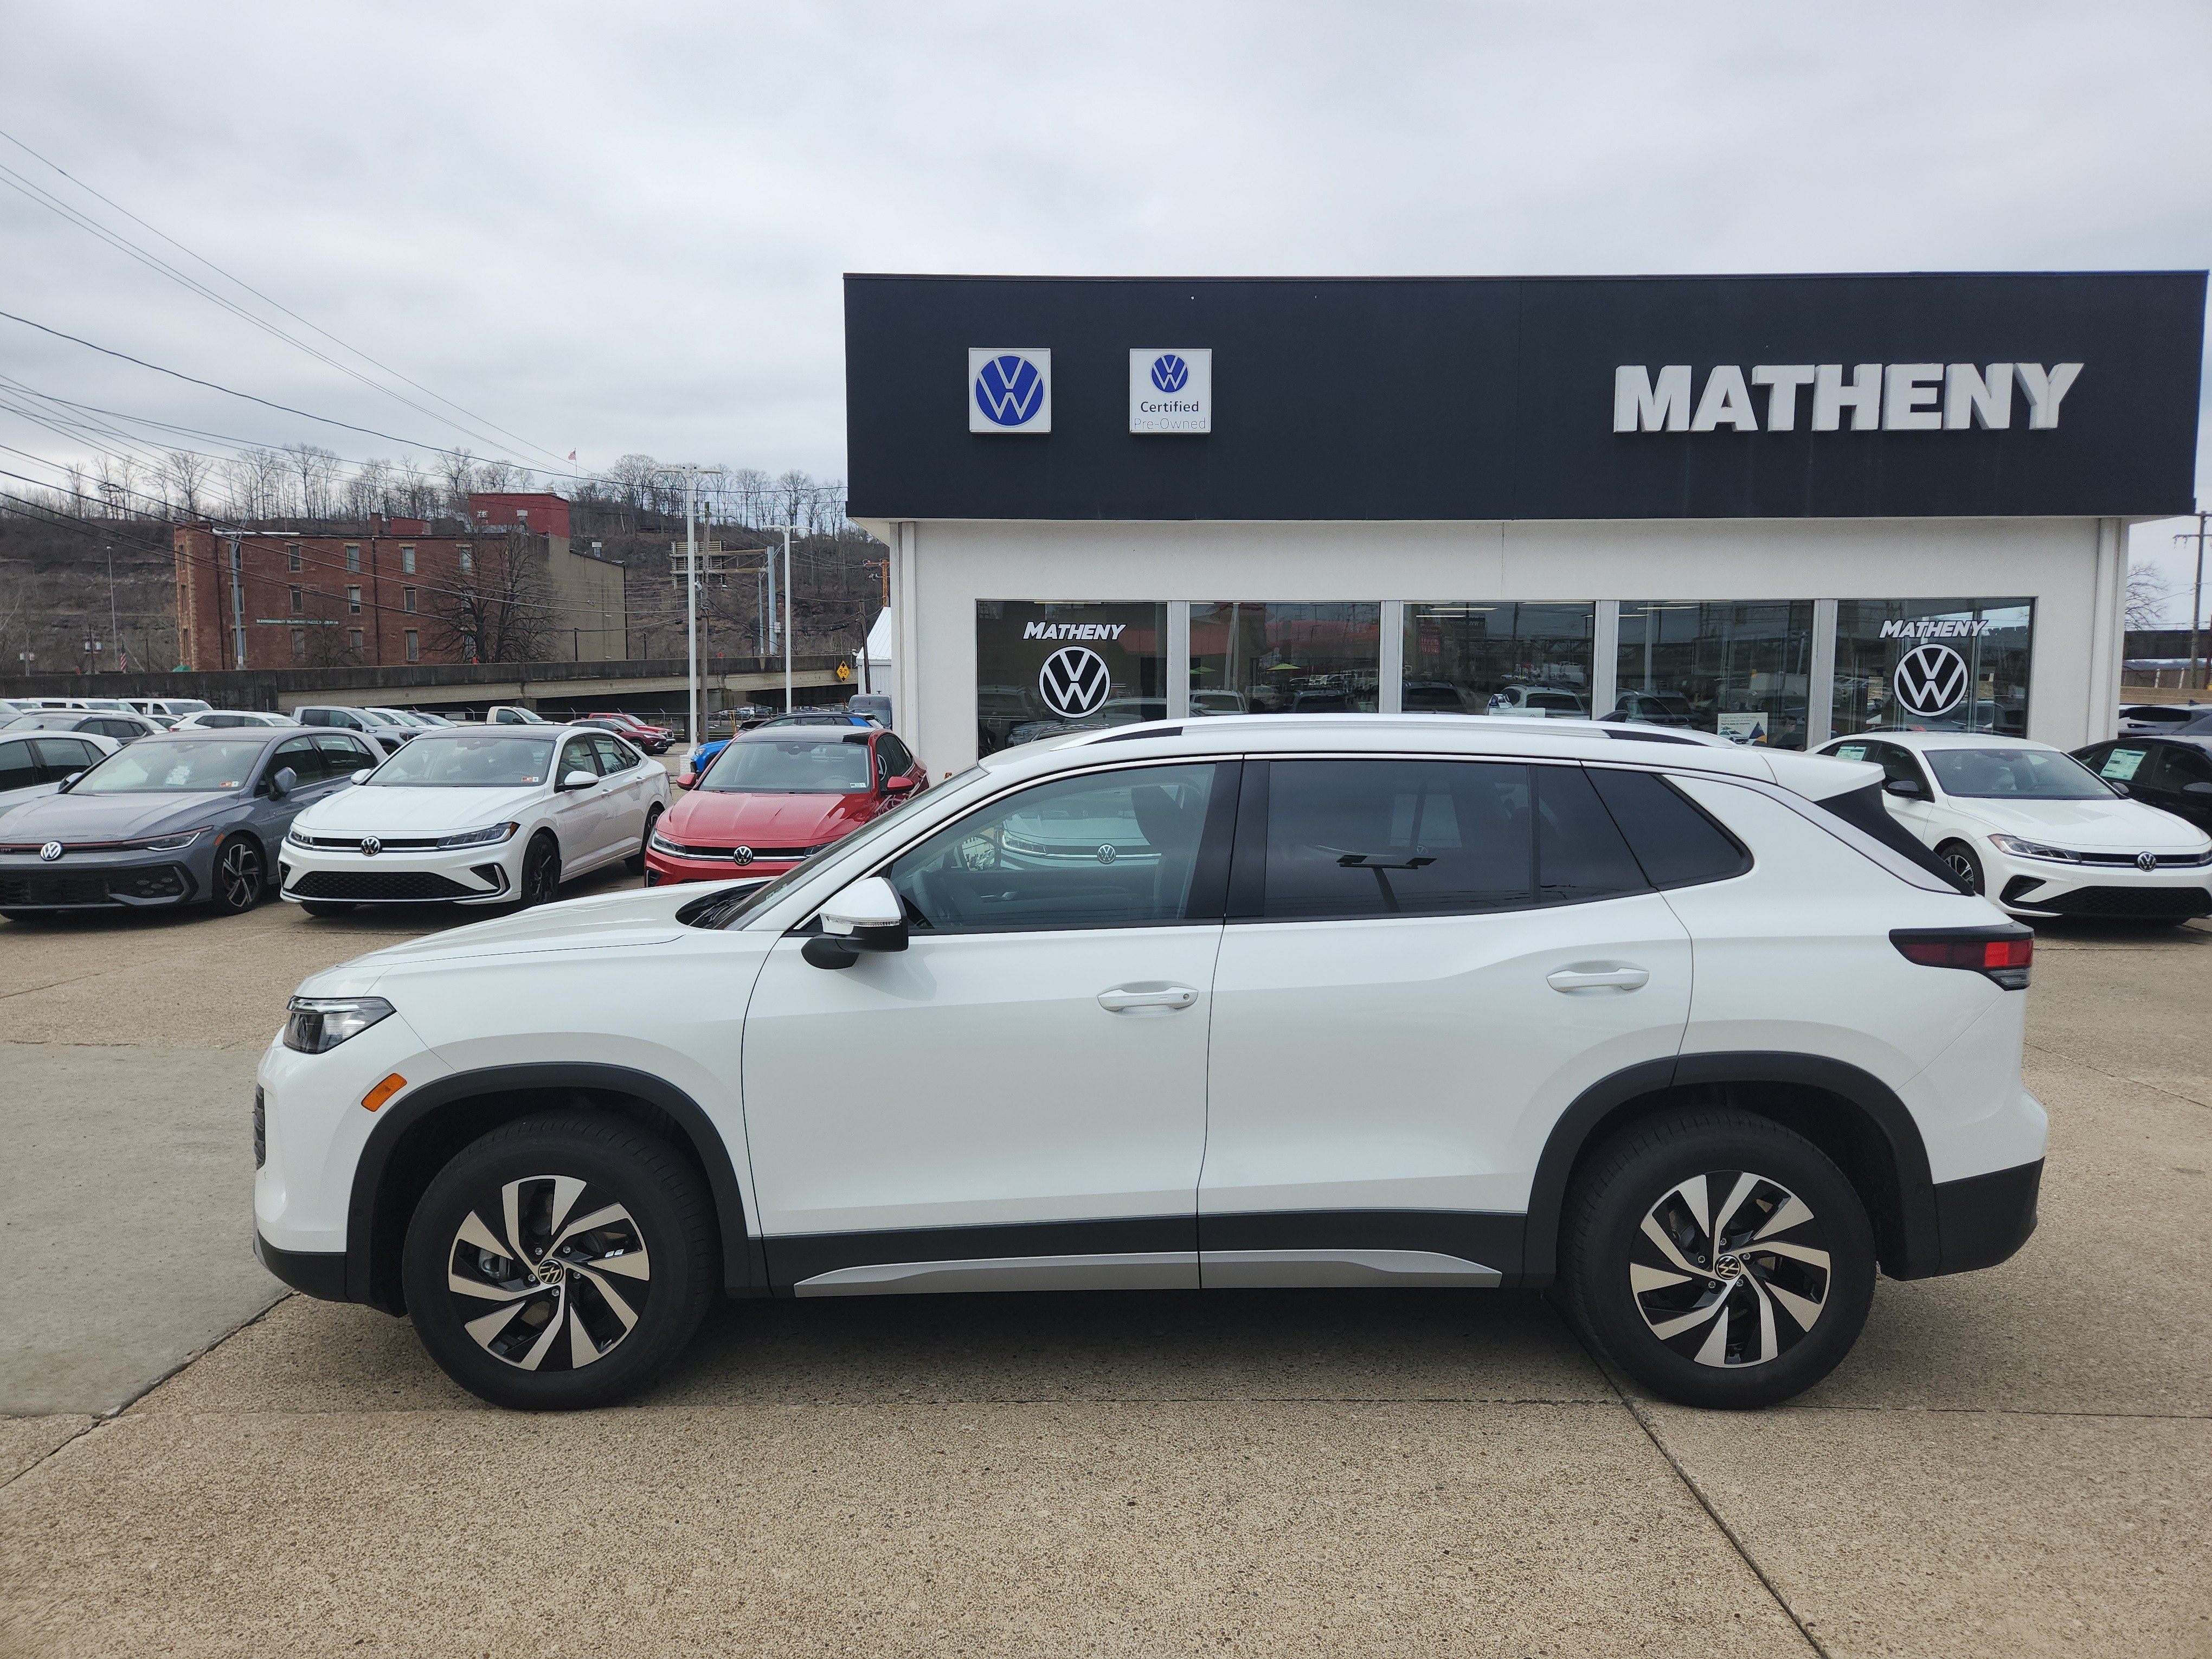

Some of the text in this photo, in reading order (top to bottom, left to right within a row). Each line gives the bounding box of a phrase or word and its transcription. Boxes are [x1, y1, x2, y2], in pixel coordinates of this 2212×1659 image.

[1140, 401, 1199, 413] Certified
[1613, 362, 2084, 433] MATHENY
[1134, 417, 1206, 429] Pre-Owned
[1023, 621, 1127, 640] MATHENY
[1879, 619, 1988, 639] MATHENY
